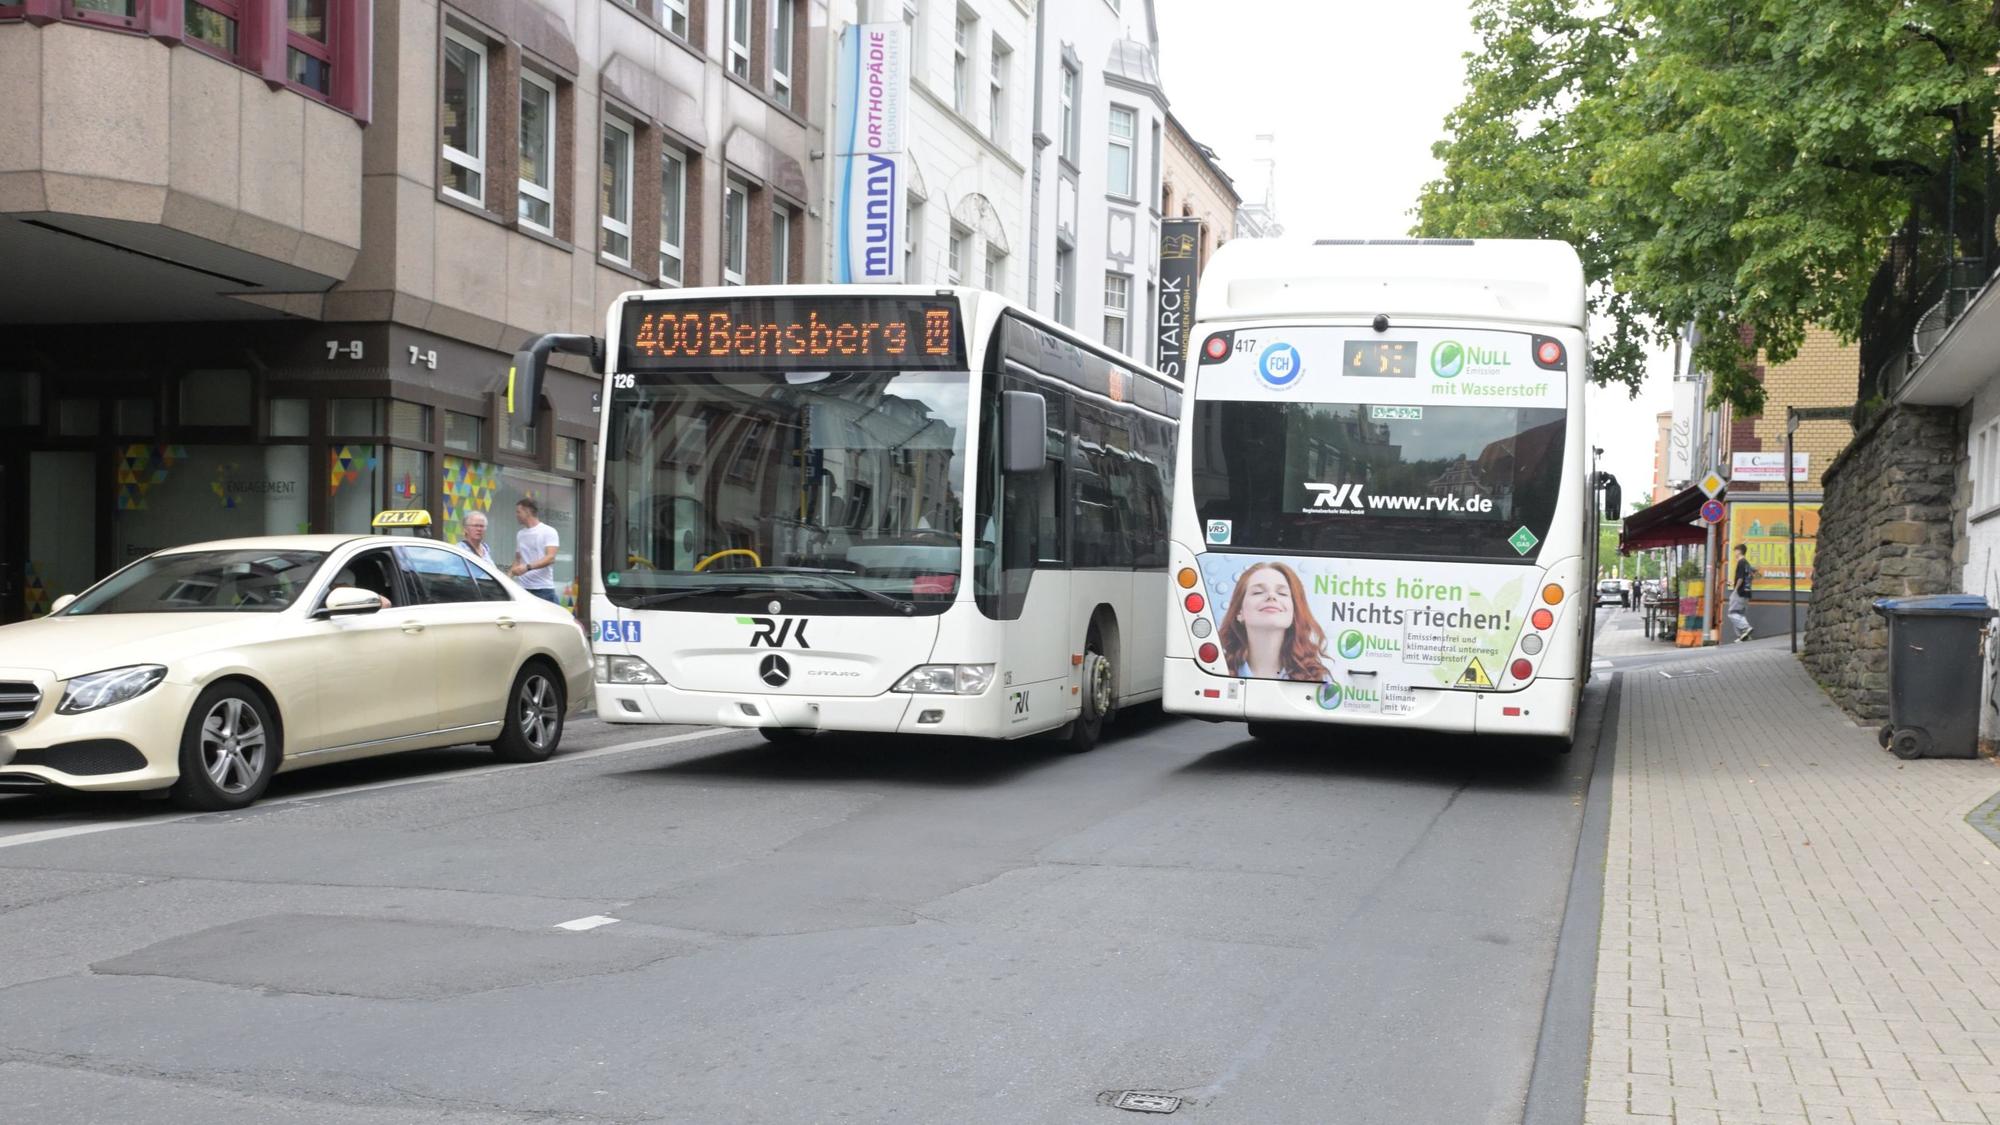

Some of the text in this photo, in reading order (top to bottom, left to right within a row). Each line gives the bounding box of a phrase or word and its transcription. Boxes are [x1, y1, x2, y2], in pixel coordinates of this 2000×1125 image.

[865, 31, 895, 276] munny ORTHOPÄDIE
[635, 313, 703, 356] 400
[709, 312, 907, 356] Bensberg
[1159, 276, 1182, 377] STARCK
[326, 340, 363, 360] 7-9
[1235, 339, 1257, 353] 417
[409, 345, 437, 369] 7-9
[1270, 356, 1290, 371] FCH
[613, 373, 635, 389] 126
[1431, 382, 1549, 397] mit Wasserstoff
[226, 480, 297, 494] ENGAGEMENT
[1303, 482, 1493, 513] RVK www.rvk.de
[380, 512, 417, 523] TAXI
[1314, 574, 1387, 598] Nichts
[1396, 577, 1463, 601] hören
[1331, 601, 1511, 631] Nichts riechen!
[736, 616, 811, 648] RVK
[1407, 632, 1477, 644] Emissionsfrei und
[1406, 642, 1499, 656] klimaneutral unterwegs
[1406, 652, 1468, 663] mit Wasserstoff
